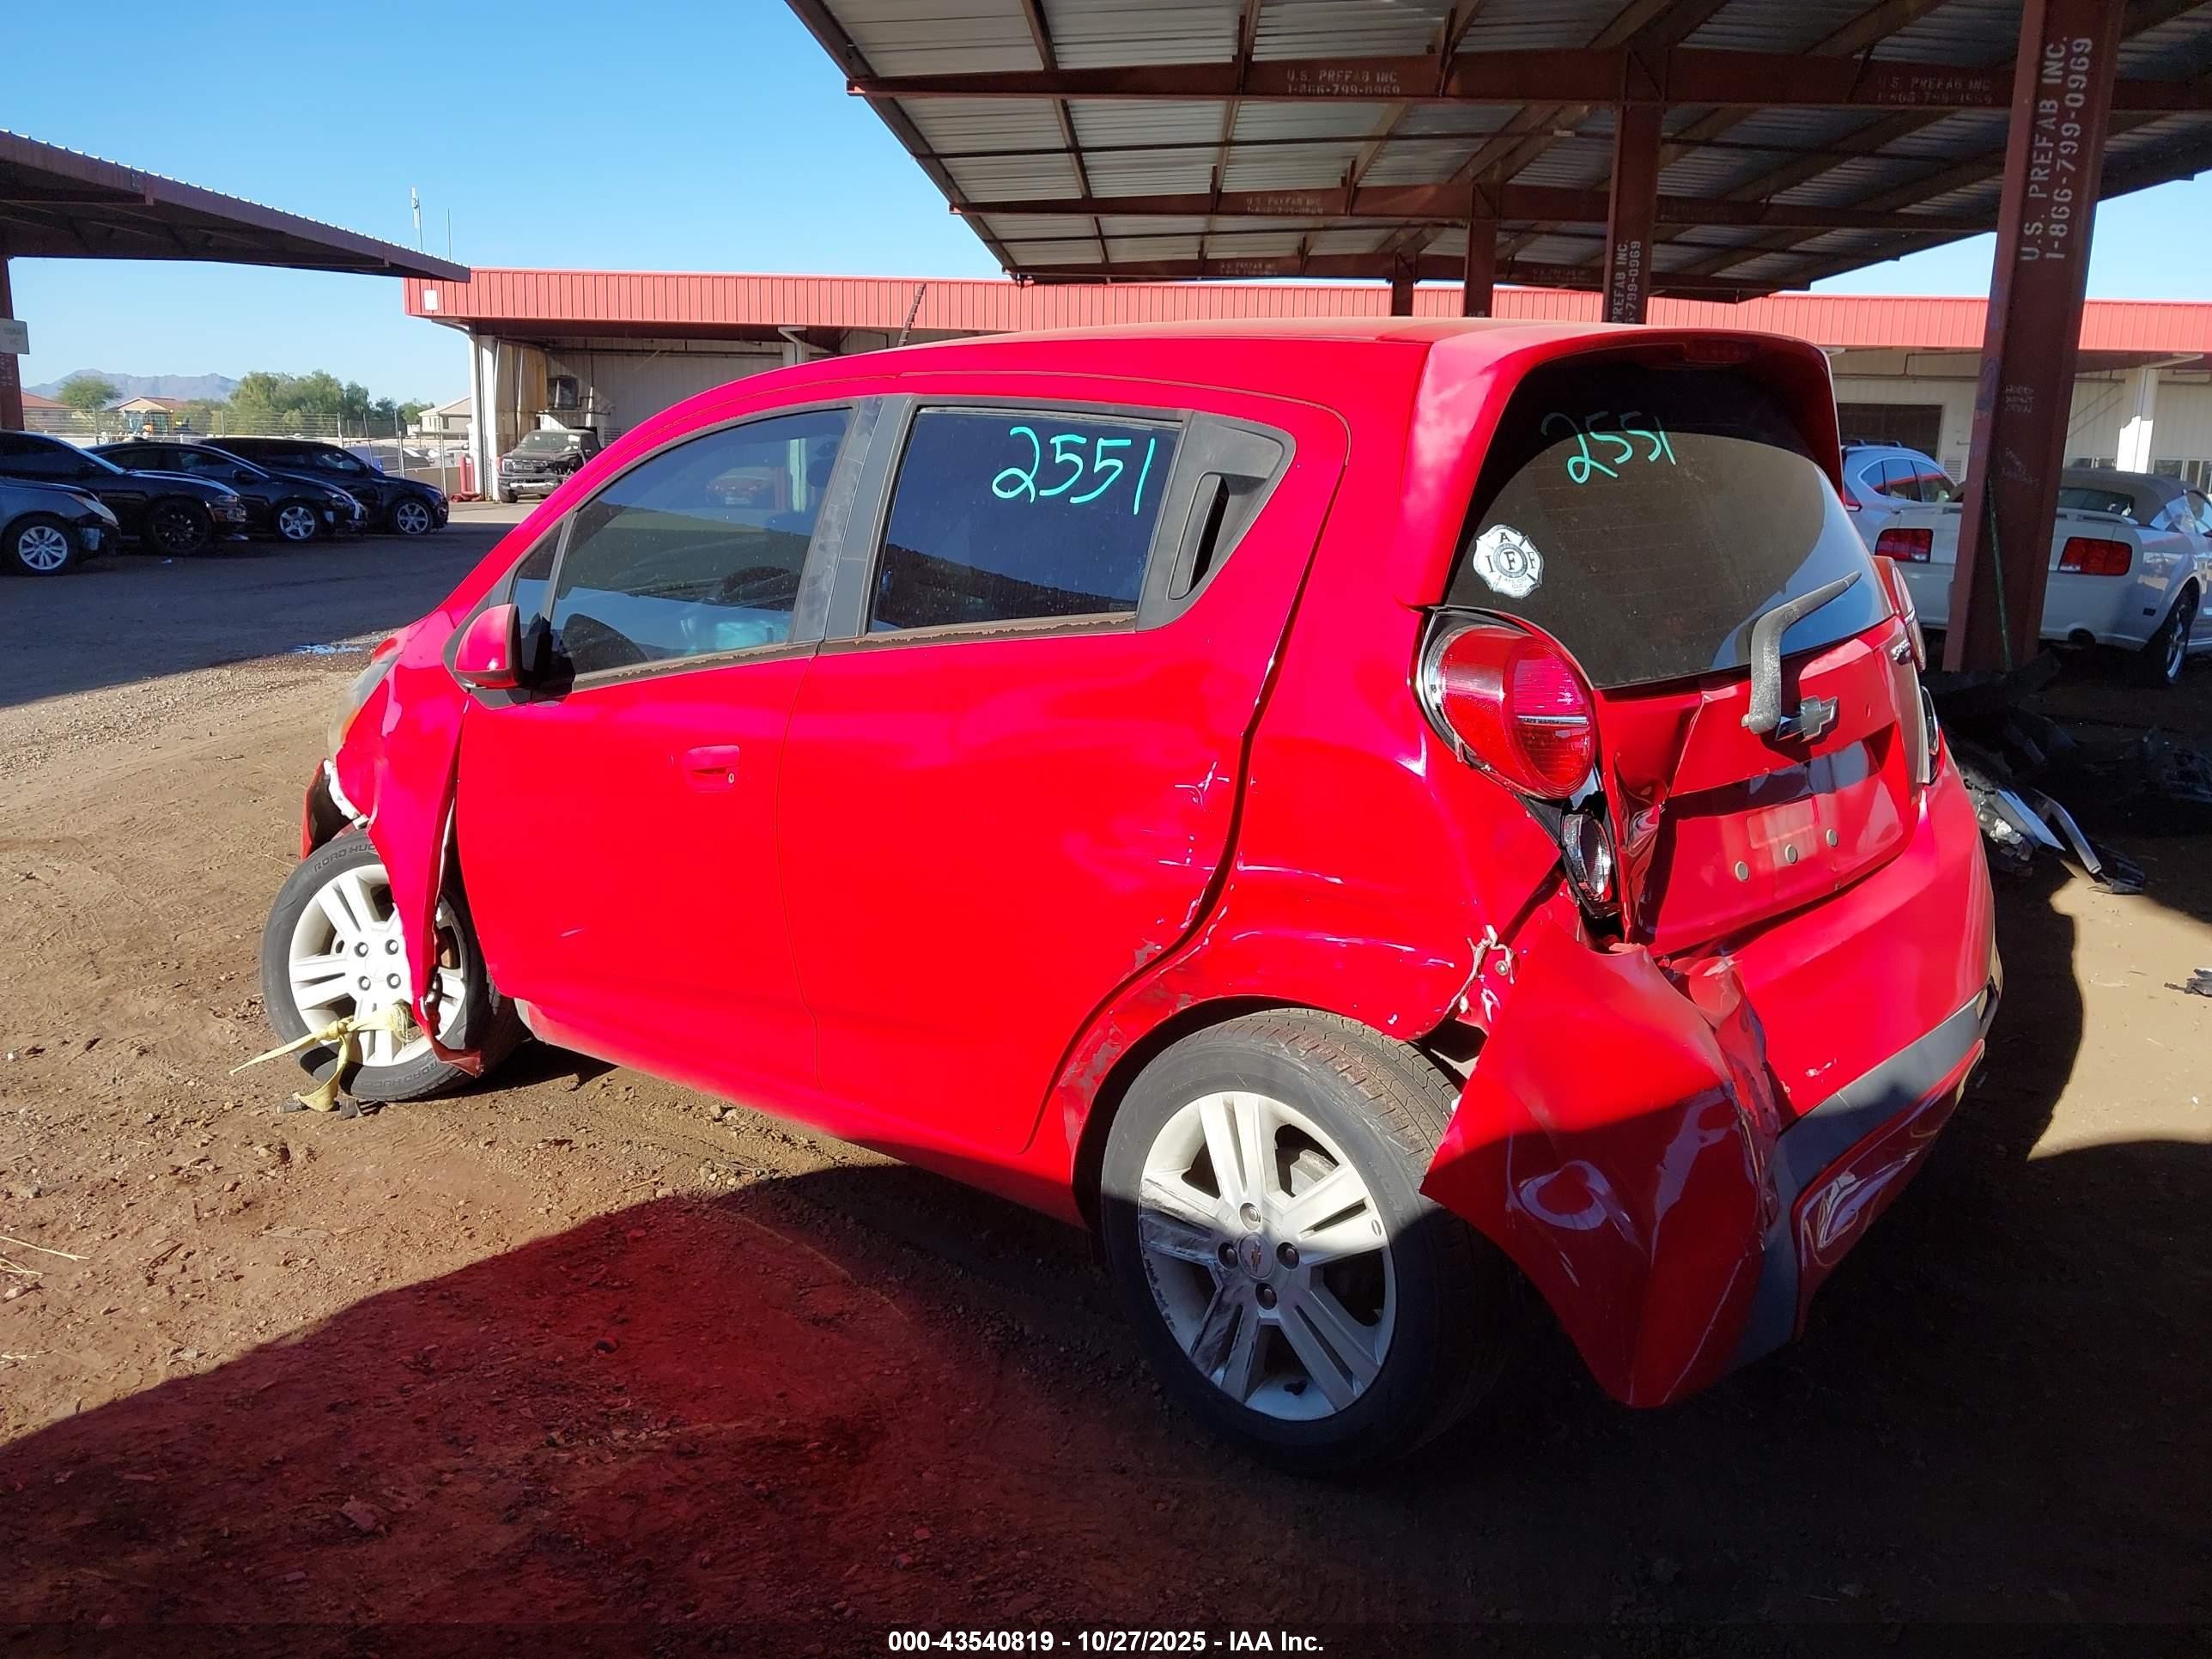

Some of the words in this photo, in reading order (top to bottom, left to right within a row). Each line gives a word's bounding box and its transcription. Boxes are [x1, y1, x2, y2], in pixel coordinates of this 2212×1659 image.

[2041, 37, 2068, 84] INC.
[2028, 99, 2059, 198] PREFAB
[2045, 37, 2093, 259] 1-866-799-0969
[992, 426, 1157, 515] 2551
[1540, 410, 1677, 485] 2551
[1499, 532, 1511, 544] A
[1504, 551, 1517, 571] F
[1526, 551, 1536, 569] F
[314, 848, 347, 872] ROAD
